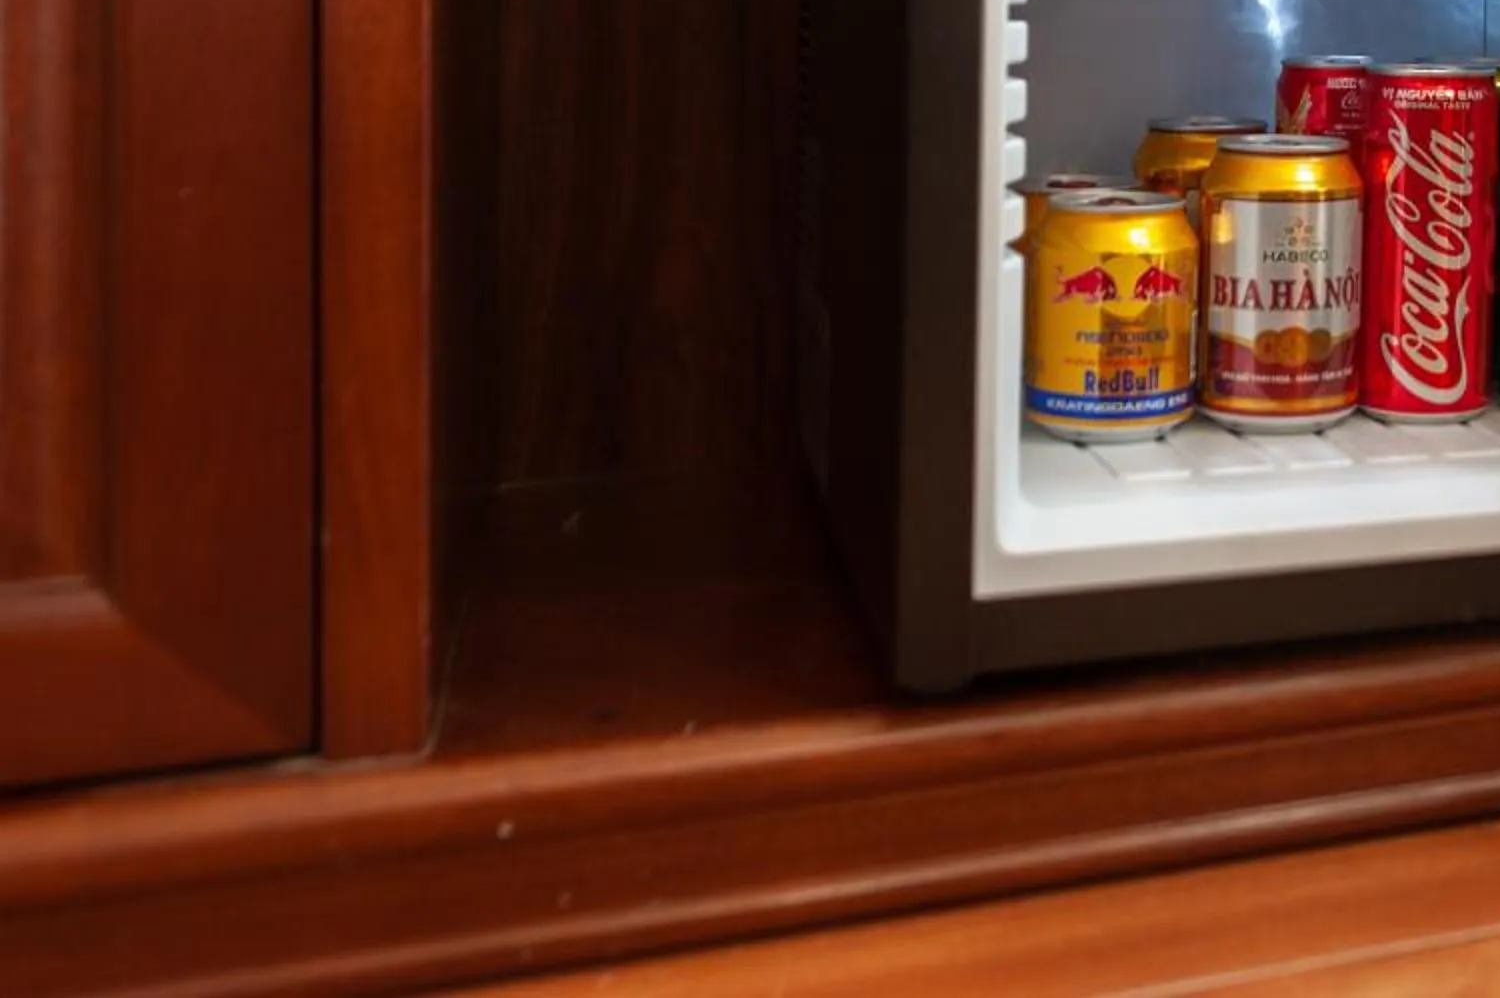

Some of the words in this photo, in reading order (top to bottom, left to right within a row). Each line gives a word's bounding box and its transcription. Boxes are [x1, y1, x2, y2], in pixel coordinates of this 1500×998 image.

[1213, 273, 1264, 311] BIA
[1269, 268, 1321, 312] HÀ
[1324, 266, 1360, 313] NỘI
[1085, 367, 1160, 392] RedBull
